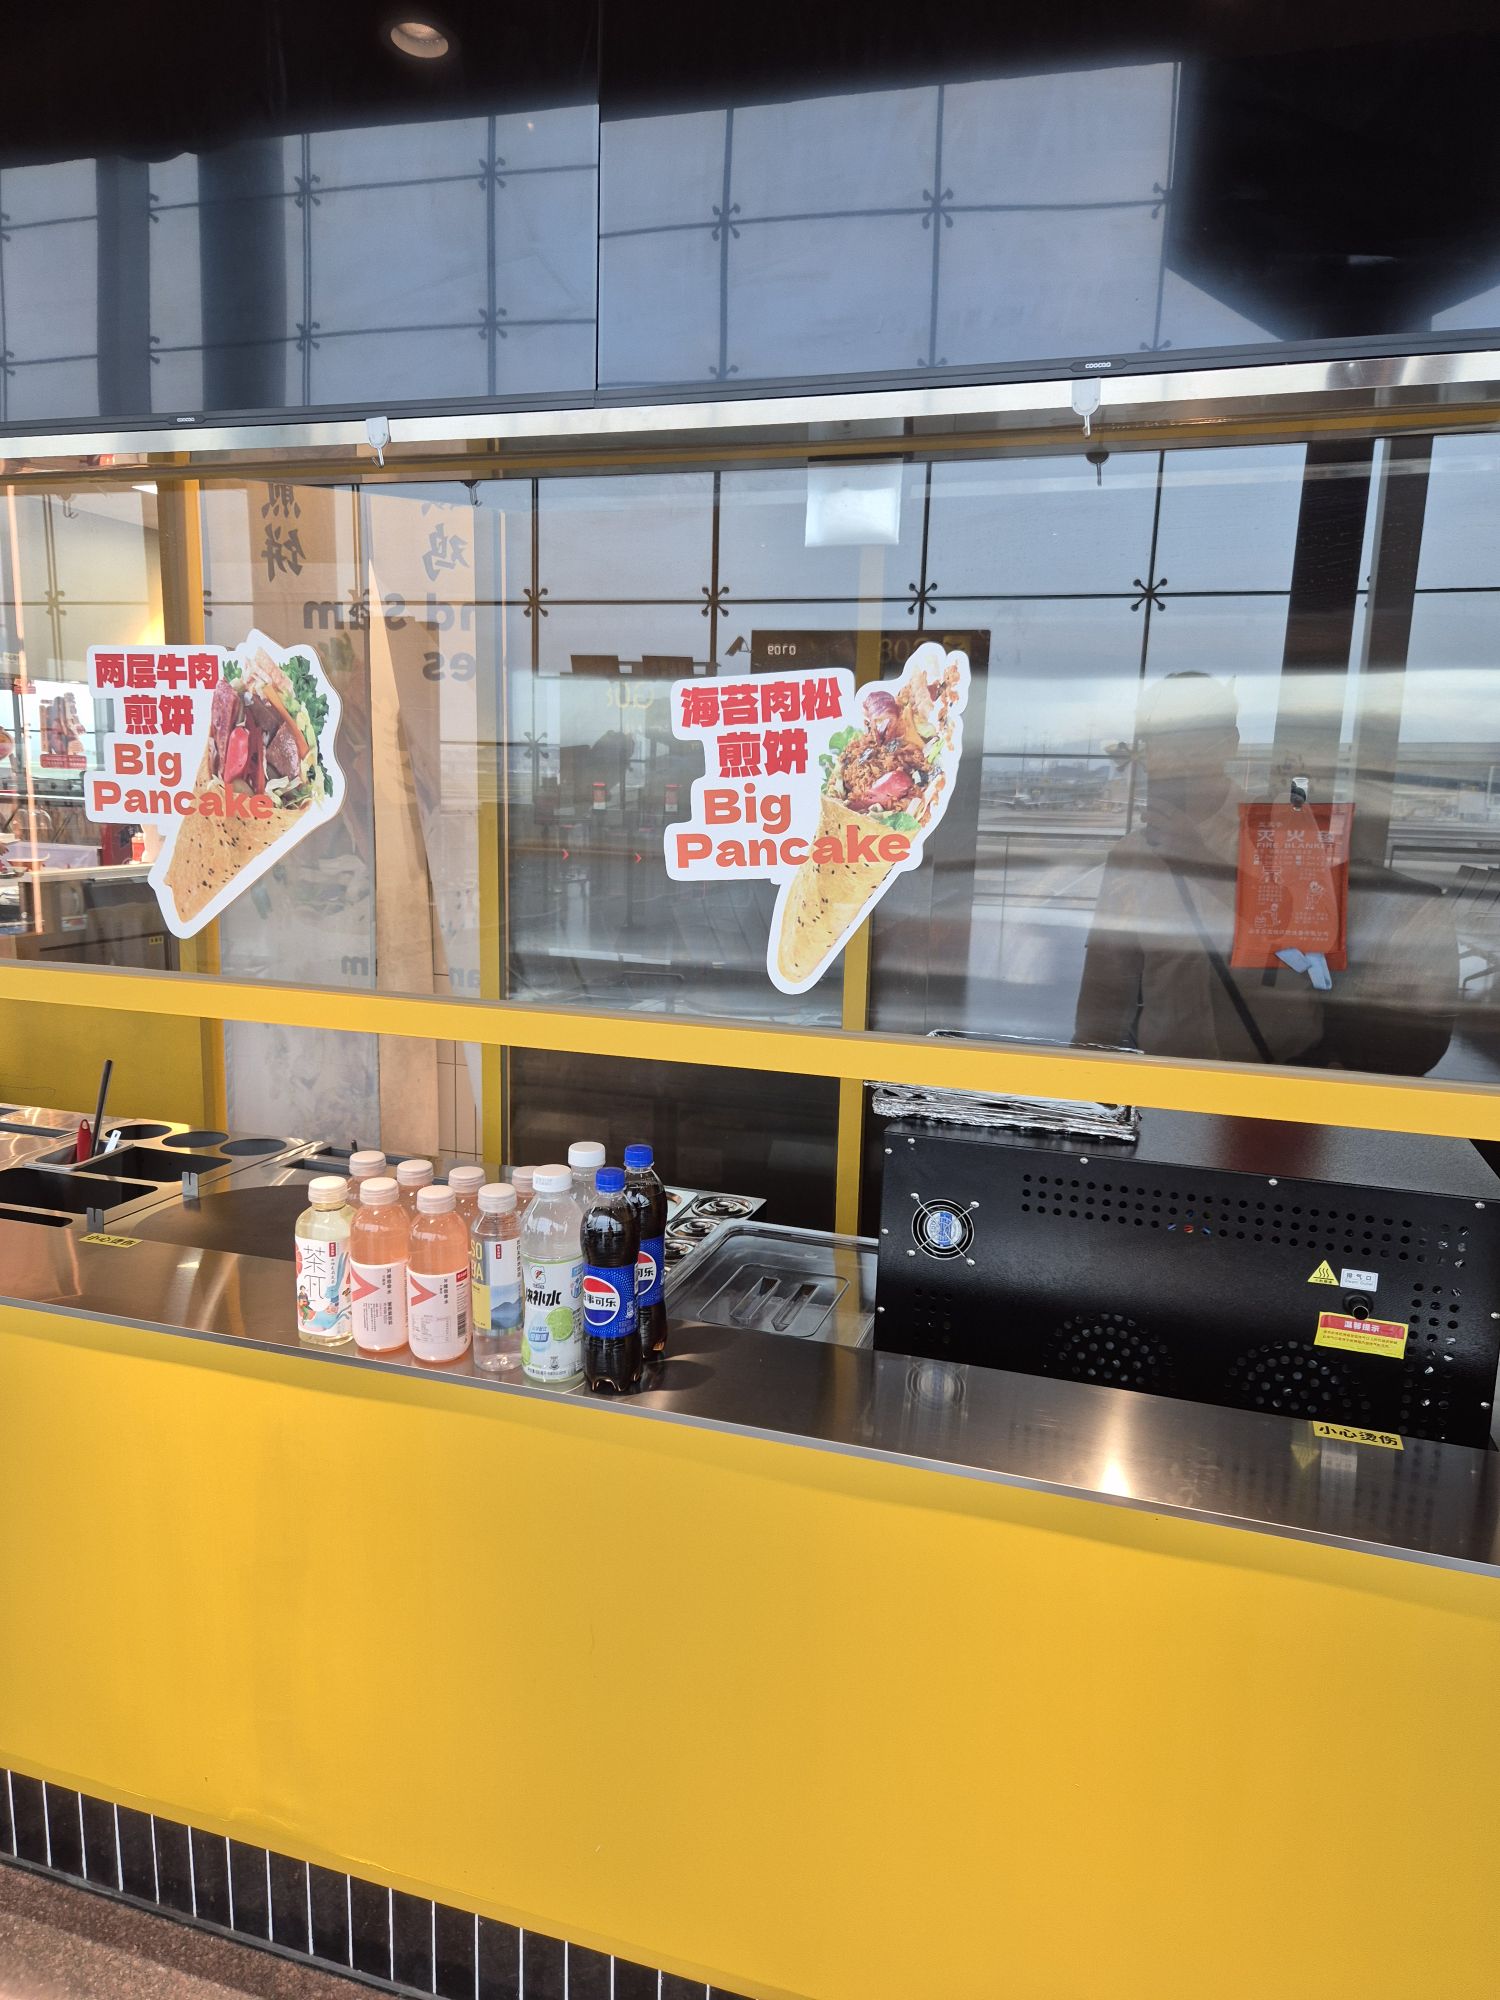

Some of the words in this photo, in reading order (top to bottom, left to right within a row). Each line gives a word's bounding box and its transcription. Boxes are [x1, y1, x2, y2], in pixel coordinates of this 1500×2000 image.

[94, 653, 219, 690] 两层牛肉
[124, 694, 195, 736] 煎饼
[681, 676, 843, 728] 海苔肉松
[113, 740, 182, 786] Big
[716, 727, 808, 778] 煎饼
[93, 781, 274, 819] Pancake
[703, 782, 791, 835] Big
[676, 825, 911, 869] Pancake
[1343, 1321, 1380, 1333] 温馨提示
[1319, 1426, 1398, 1446] 小心烫伤
